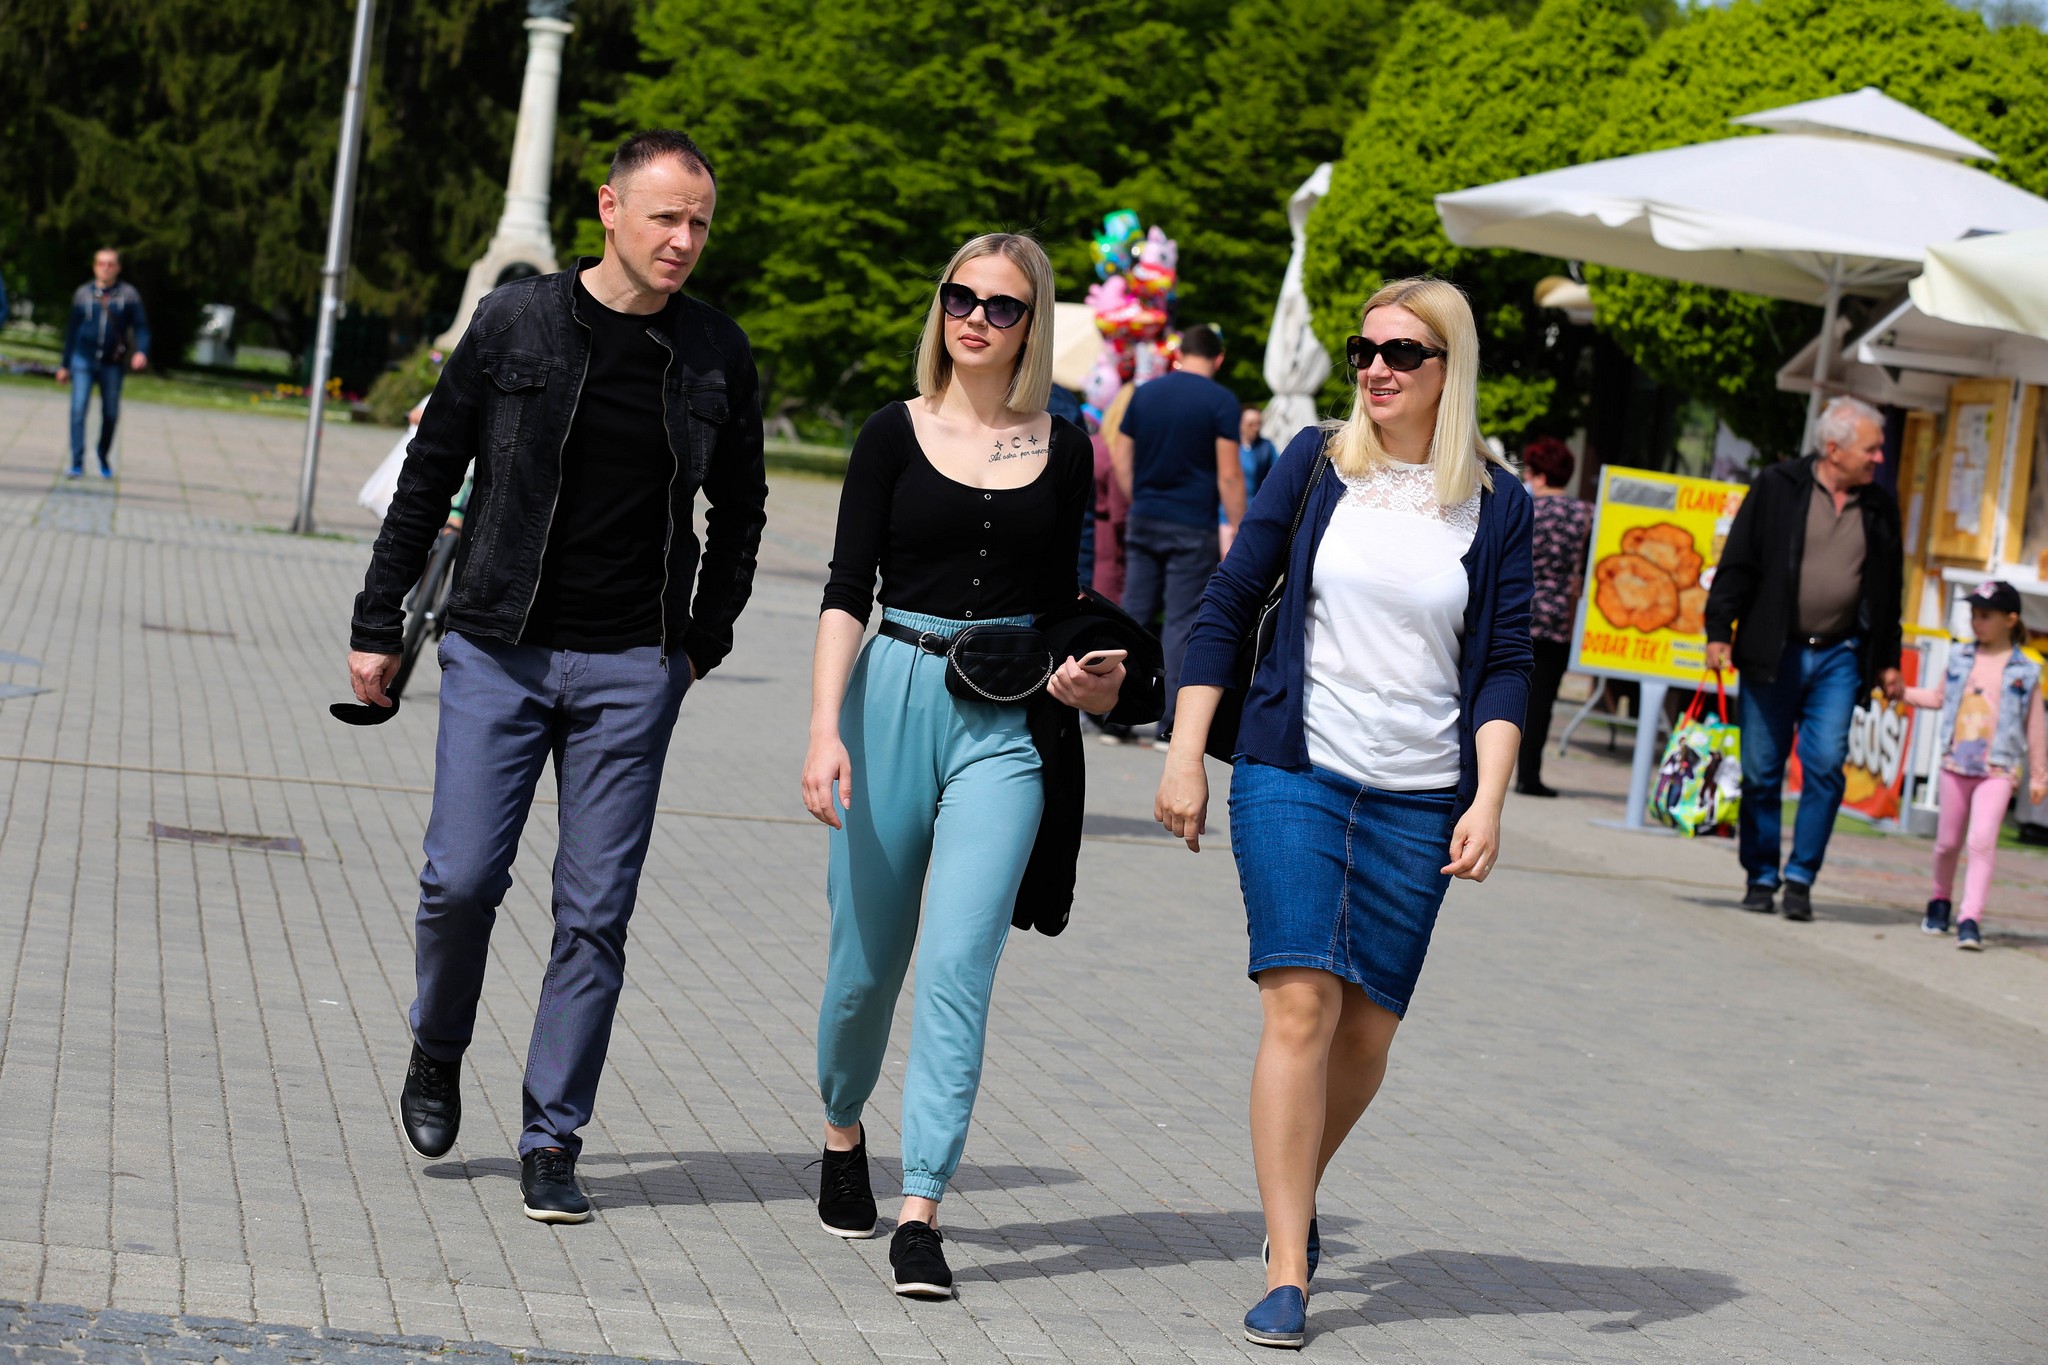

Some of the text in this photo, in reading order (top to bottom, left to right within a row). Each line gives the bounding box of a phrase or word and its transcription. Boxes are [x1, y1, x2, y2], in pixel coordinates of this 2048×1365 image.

[988, 451, 1002, 463] Ad
[1003, 452, 1017, 460] astra
[1020, 451, 1030, 459] per
